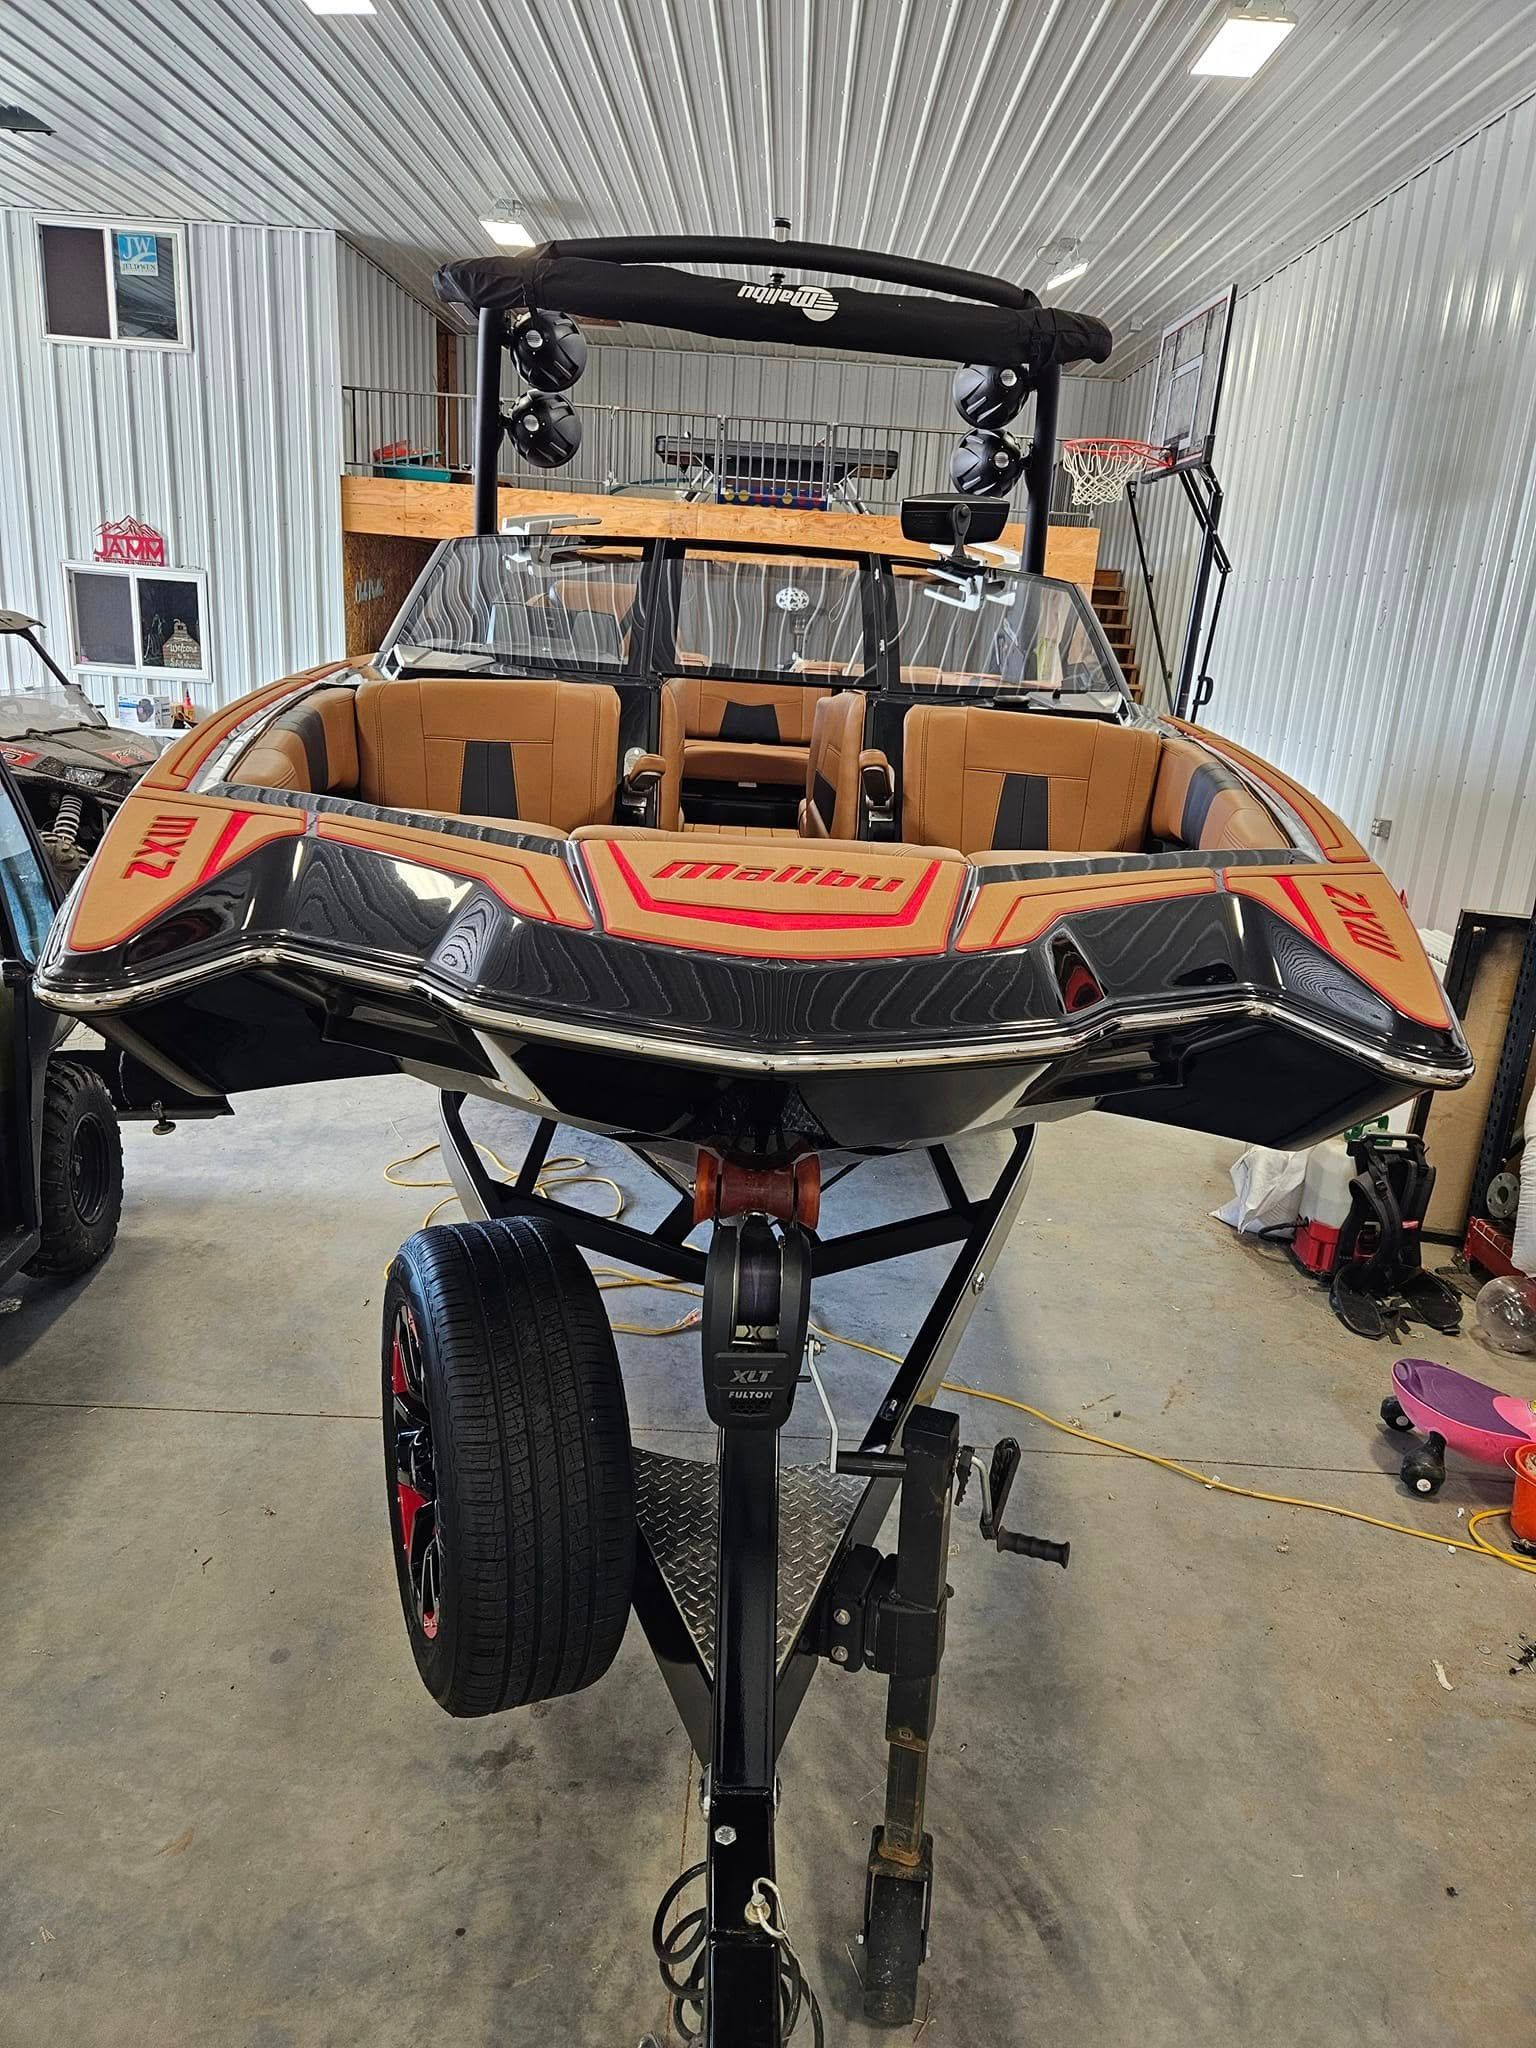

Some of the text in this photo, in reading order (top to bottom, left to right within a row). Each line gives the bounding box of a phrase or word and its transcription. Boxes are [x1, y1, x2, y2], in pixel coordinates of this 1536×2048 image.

[122, 236, 152, 260] JW
[93, 534, 164, 561] JAMM
[122, 815, 199, 880] MXZ
[1321, 883, 1404, 962] MXZ
[729, 1369, 774, 1384] XLT
[728, 1391, 773, 1399] FULTON
